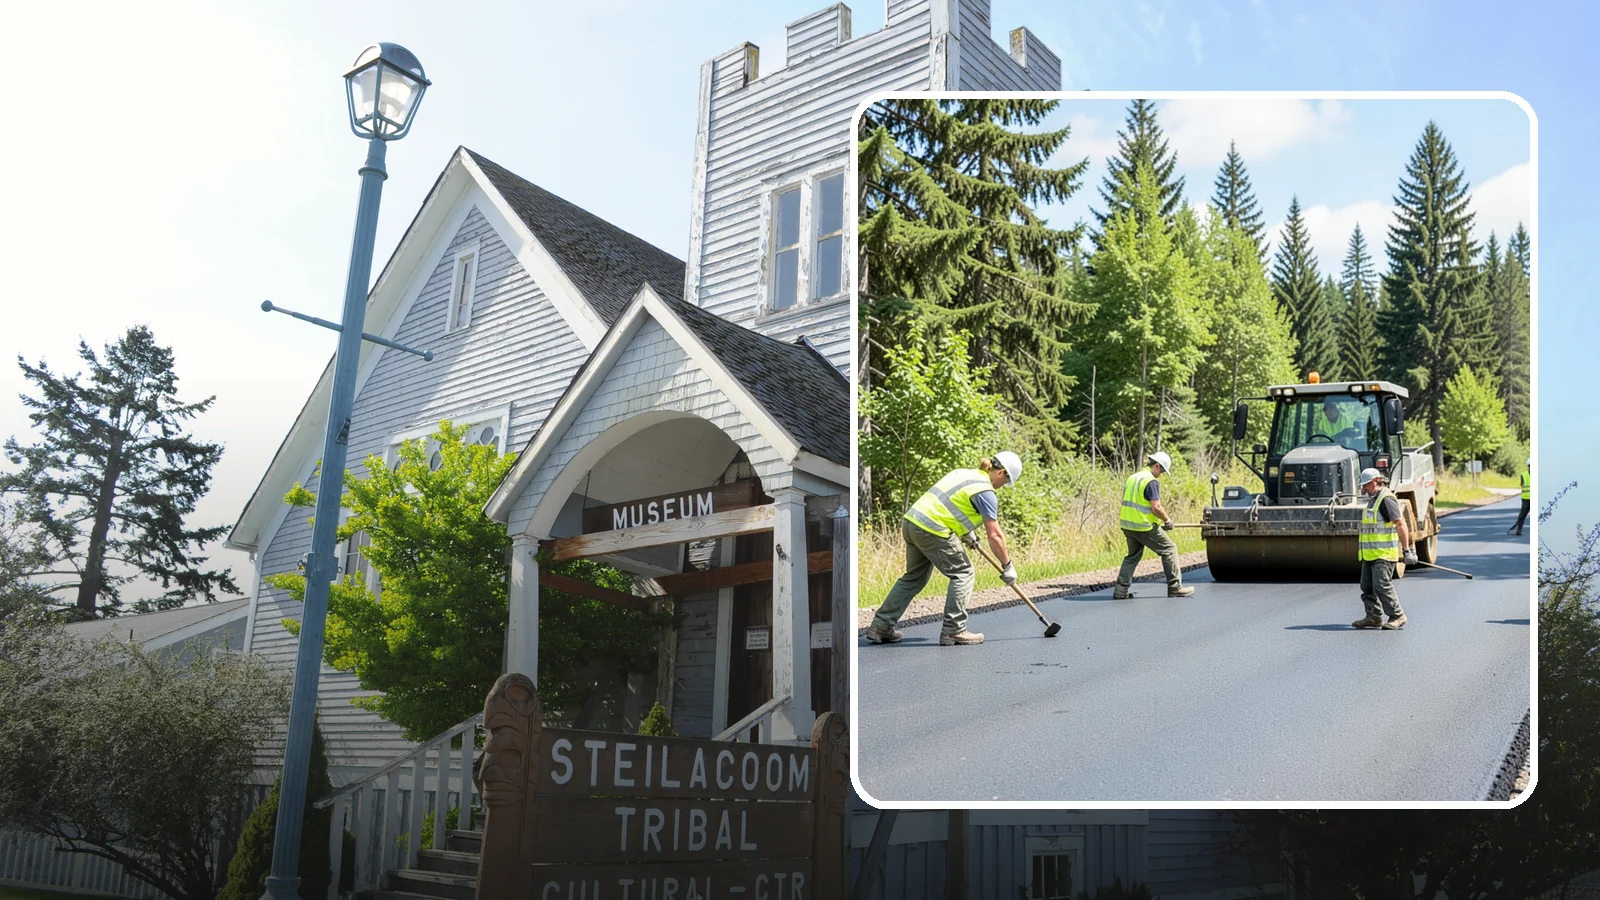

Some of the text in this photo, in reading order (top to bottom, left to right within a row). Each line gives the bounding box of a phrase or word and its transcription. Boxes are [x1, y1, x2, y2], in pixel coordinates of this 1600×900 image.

[613, 492, 713, 530] MUSEUM
[551, 738, 809, 792] STEILACOOM
[615, 807, 757, 851] TRIBAL
